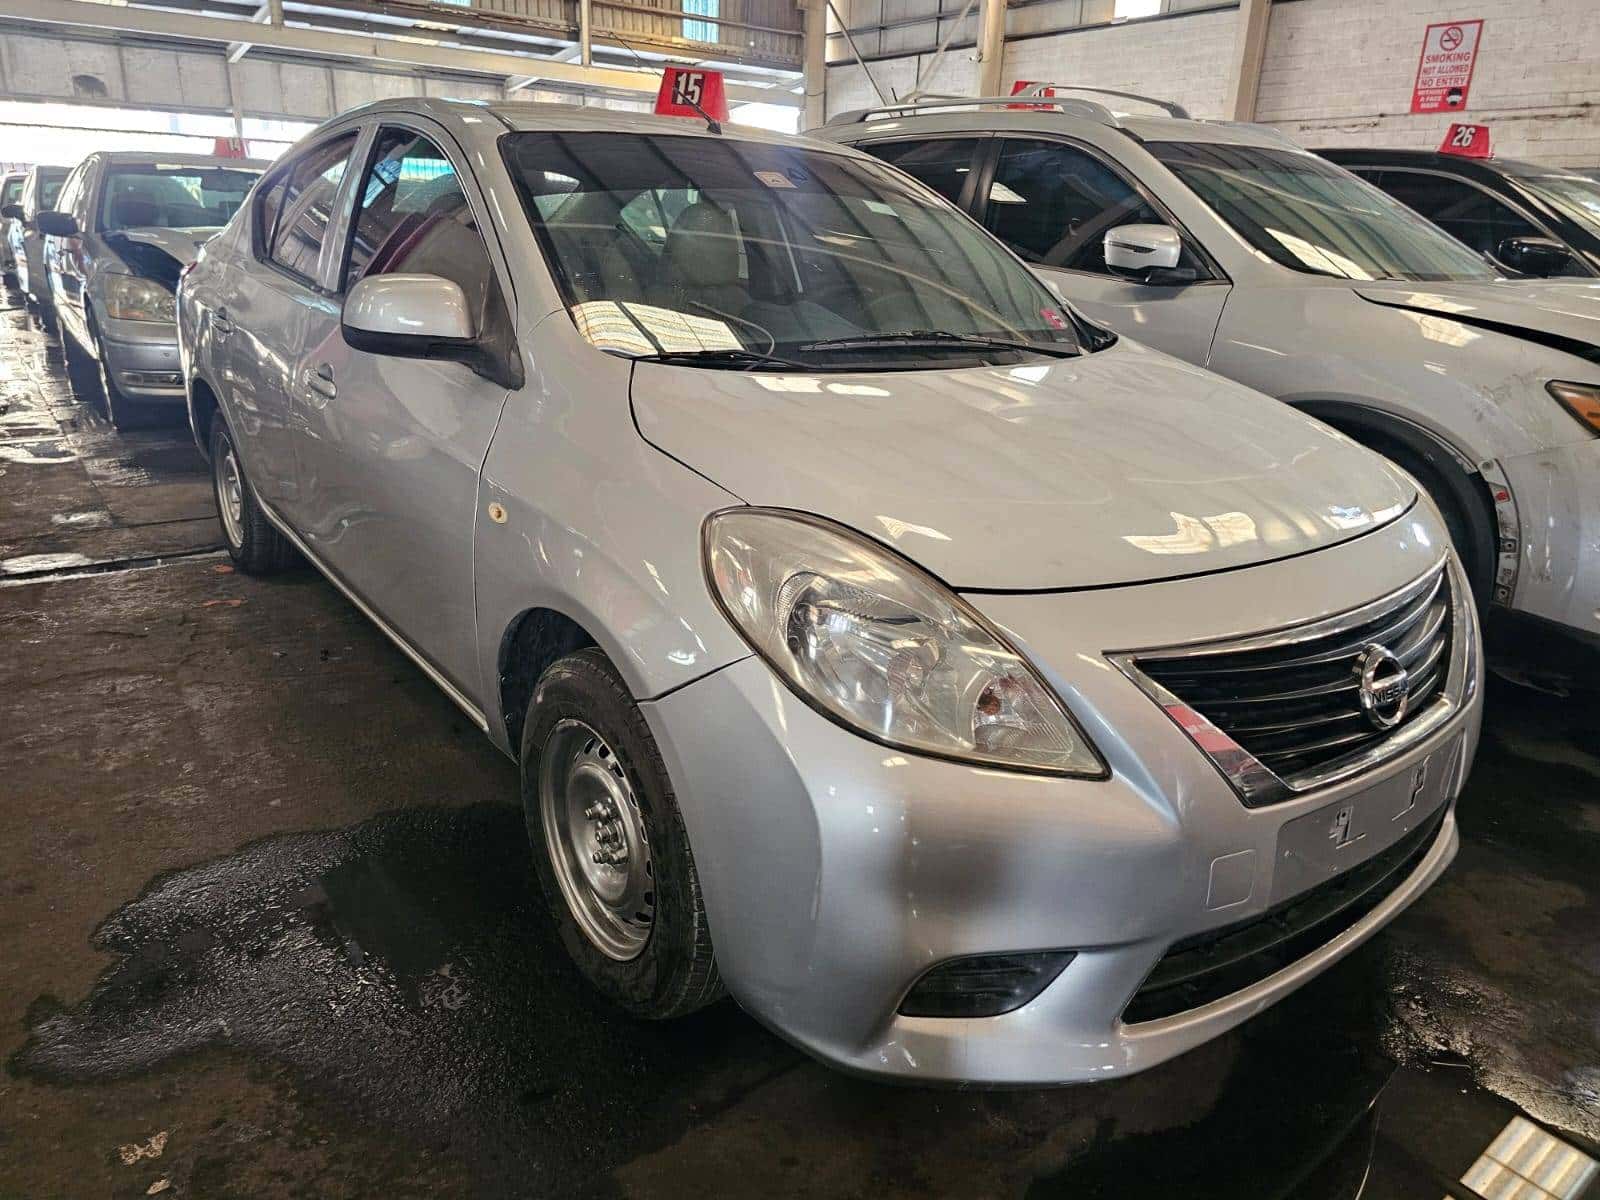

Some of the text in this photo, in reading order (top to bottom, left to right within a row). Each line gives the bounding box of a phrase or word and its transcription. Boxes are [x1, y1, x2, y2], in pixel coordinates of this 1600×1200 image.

[1425, 52, 1471, 64] SMOKING
[1437, 64, 1469, 74] ALLOWED
[676, 72, 703, 105] 15
[1421, 76, 1466, 87] NO ENTRY
[1451, 126, 1476, 147] 26
[1370, 683, 1407, 705] NISS
